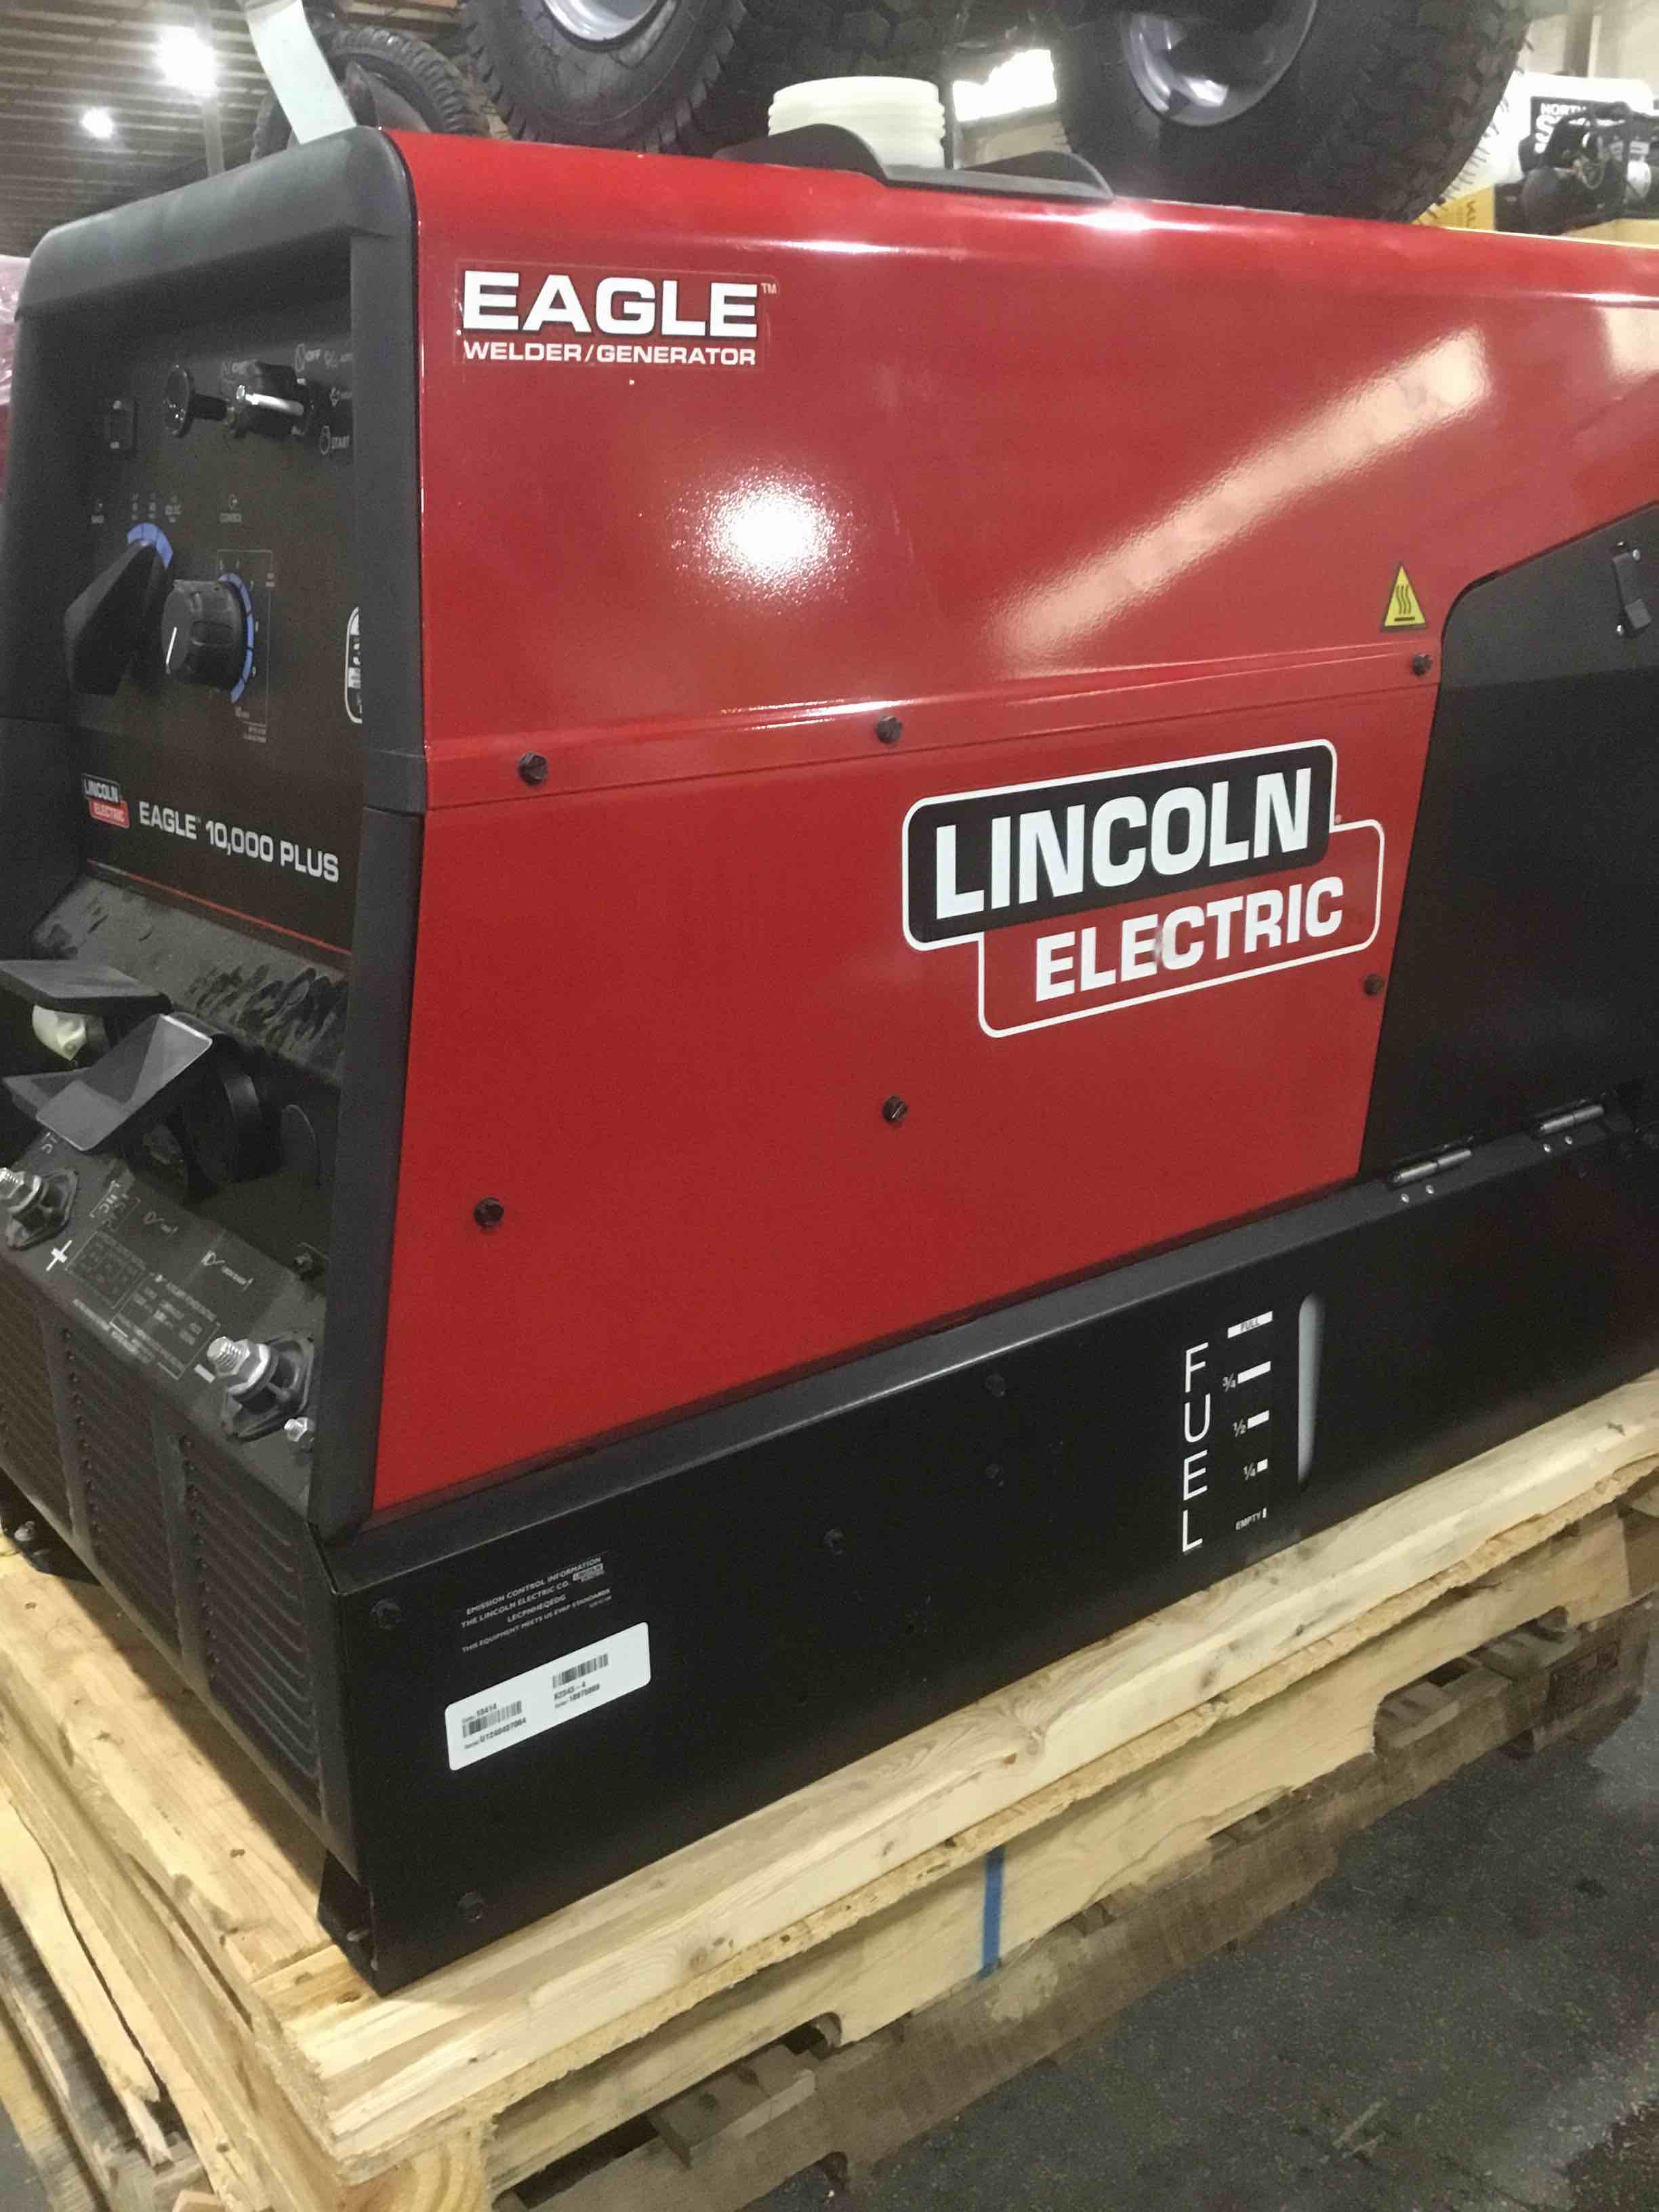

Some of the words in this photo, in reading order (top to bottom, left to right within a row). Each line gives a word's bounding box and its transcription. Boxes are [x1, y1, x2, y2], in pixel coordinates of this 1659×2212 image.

[464, 270, 758, 337] EAGLE
[464, 340, 756, 366] WELDER/GENERATOR
[84, 778, 119, 803] LINCOLN
[93, 802, 125, 823] ELECTRIC
[139, 801, 197, 840] EAGLE
[205, 820, 273, 862] 10,000
[280, 840, 340, 882] PLUS
[936, 767, 1311, 920] LINCOLN
[1036, 876, 1344, 1002] ELECTRIC
[1182, 1342, 1211, 1553] FUEL
[1235, 1512, 1261, 1531] EMPTY
[461, 1617, 478, 1628] THE
[479, 1599, 516, 1622] LINCOLN
[517, 1585, 556, 1606] ELECTRIC
[466, 1595, 505, 1616] EMISSION
[507, 1579, 546, 1599] CONTROL
[547, 1556, 602, 1582] INFORMATION
[462, 1642, 478, 1654] THIS
[479, 1625, 520, 1646] EQUIPMENT
[521, 1615, 543, 1629] MEETS
[544, 1612, 554, 1620] US
[572, 1588, 611, 1608] STANDARDS
